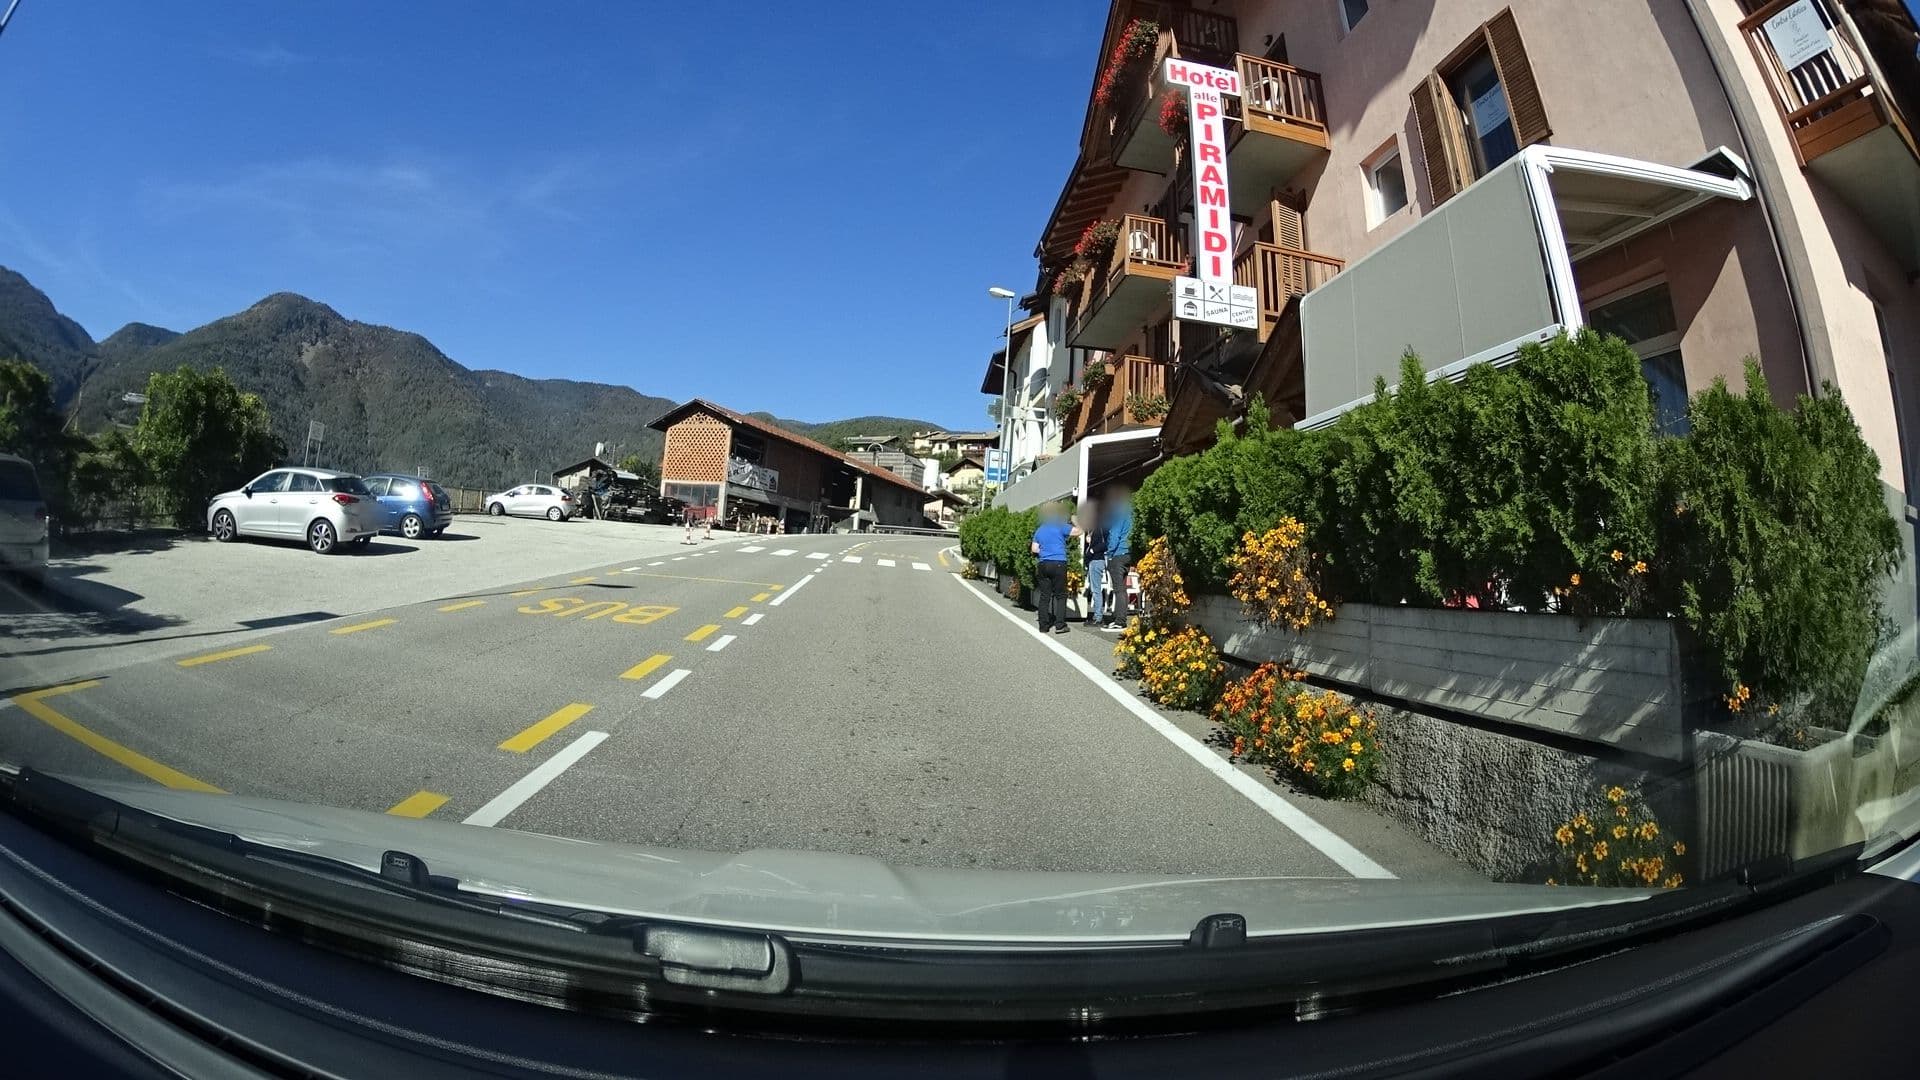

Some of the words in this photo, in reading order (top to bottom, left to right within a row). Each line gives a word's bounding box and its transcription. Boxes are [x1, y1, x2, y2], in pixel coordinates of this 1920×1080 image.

[1170, 64, 1237, 93] Hotel
[1194, 92, 1217, 103] alle
[1197, 103, 1227, 277] PIRAMIDI
[1206, 307, 1228, 317] SAUNA
[1232, 309, 1253, 318] CENTRO
[518, 597, 680, 625] BUS
